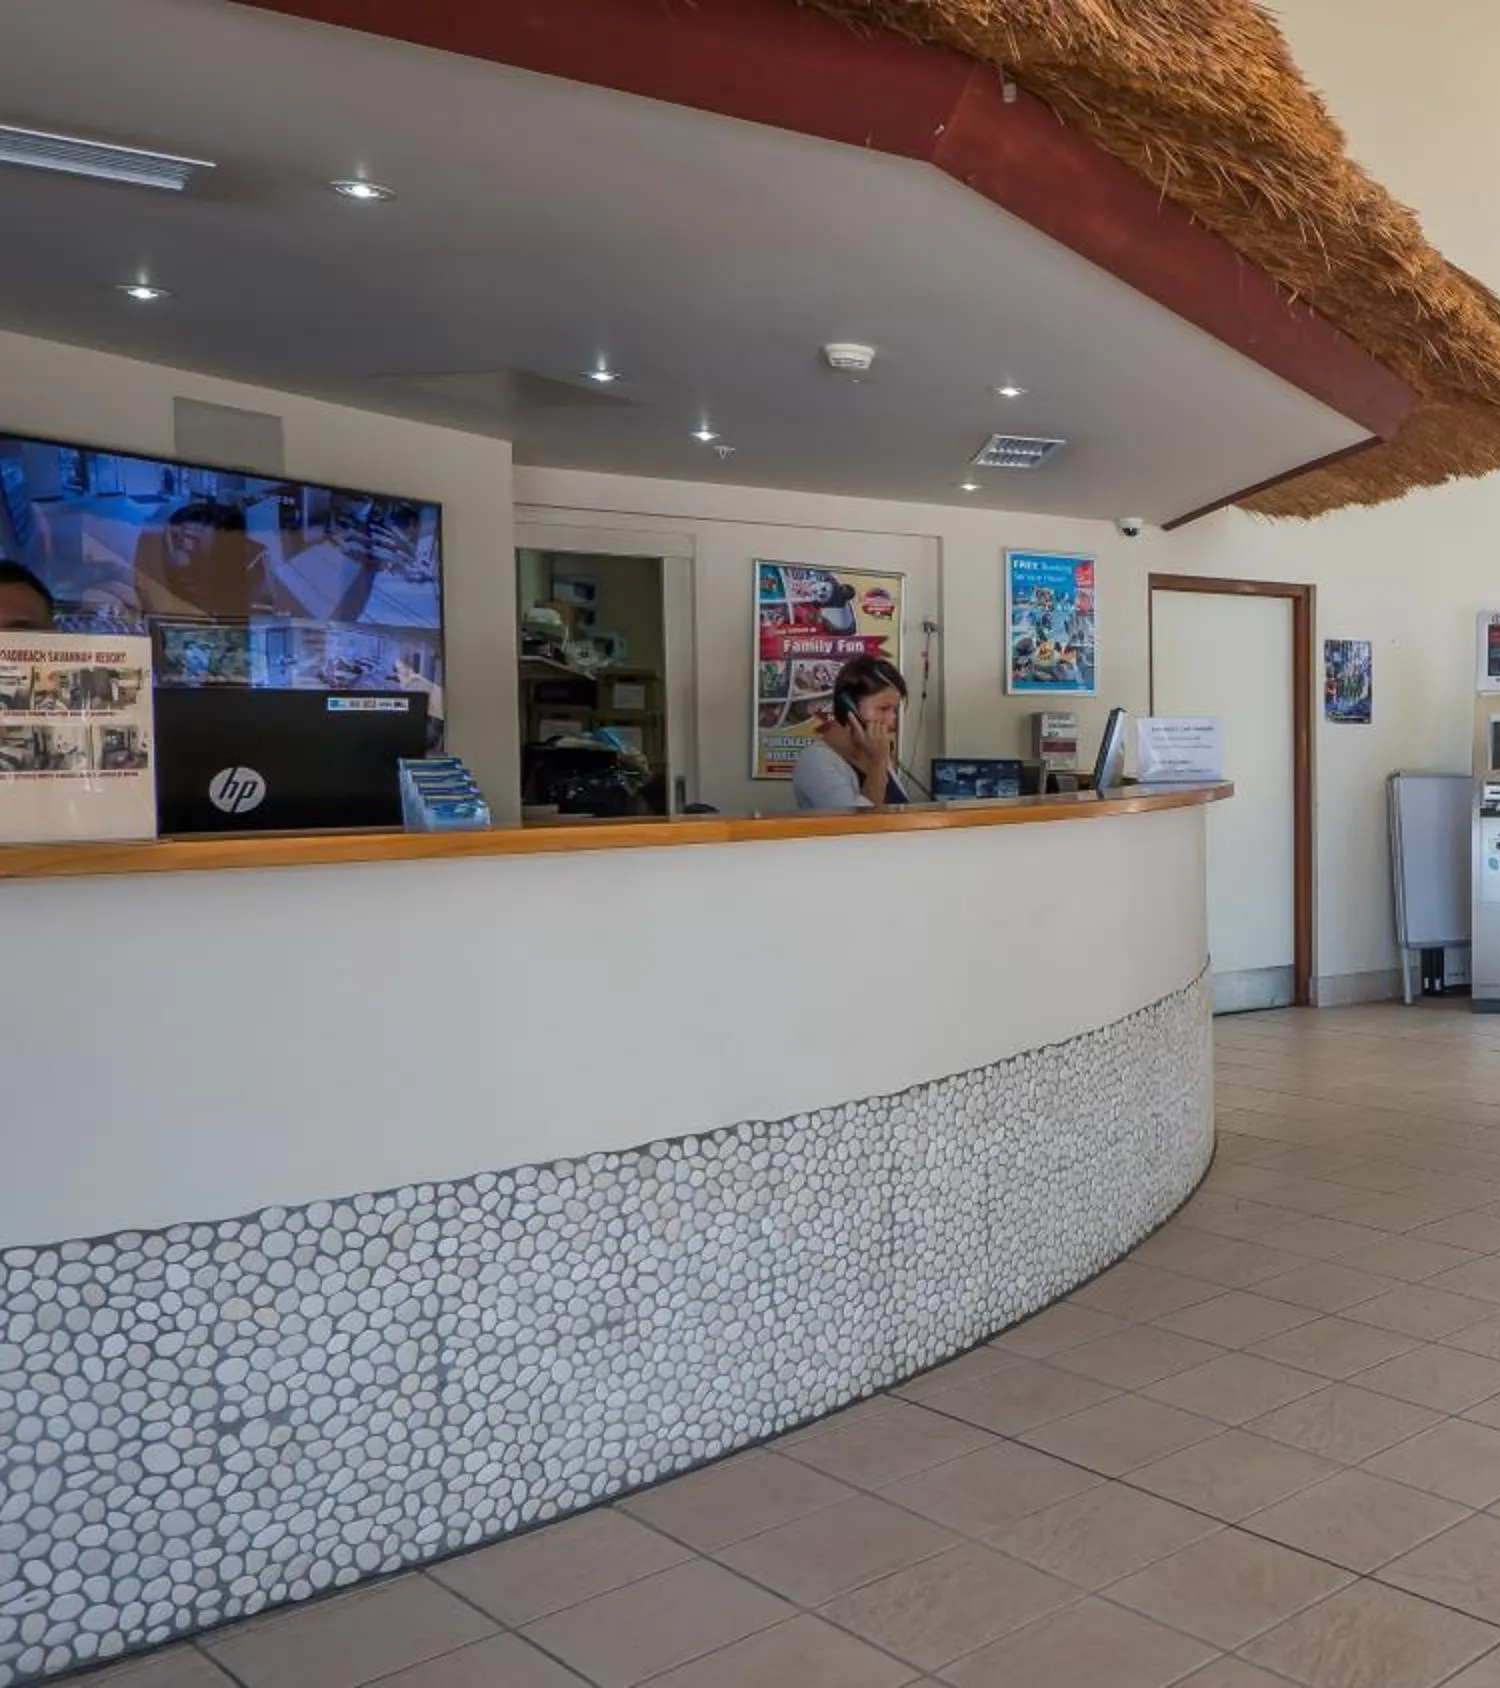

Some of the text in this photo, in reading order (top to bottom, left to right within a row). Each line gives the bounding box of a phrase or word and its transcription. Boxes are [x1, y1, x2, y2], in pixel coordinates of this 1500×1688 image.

[1013, 560, 1038, 570] FREE
[783, 639, 865, 655] Family Fun
[95, 652, 127, 663] RESORT
[219, 767, 257, 813] hp
